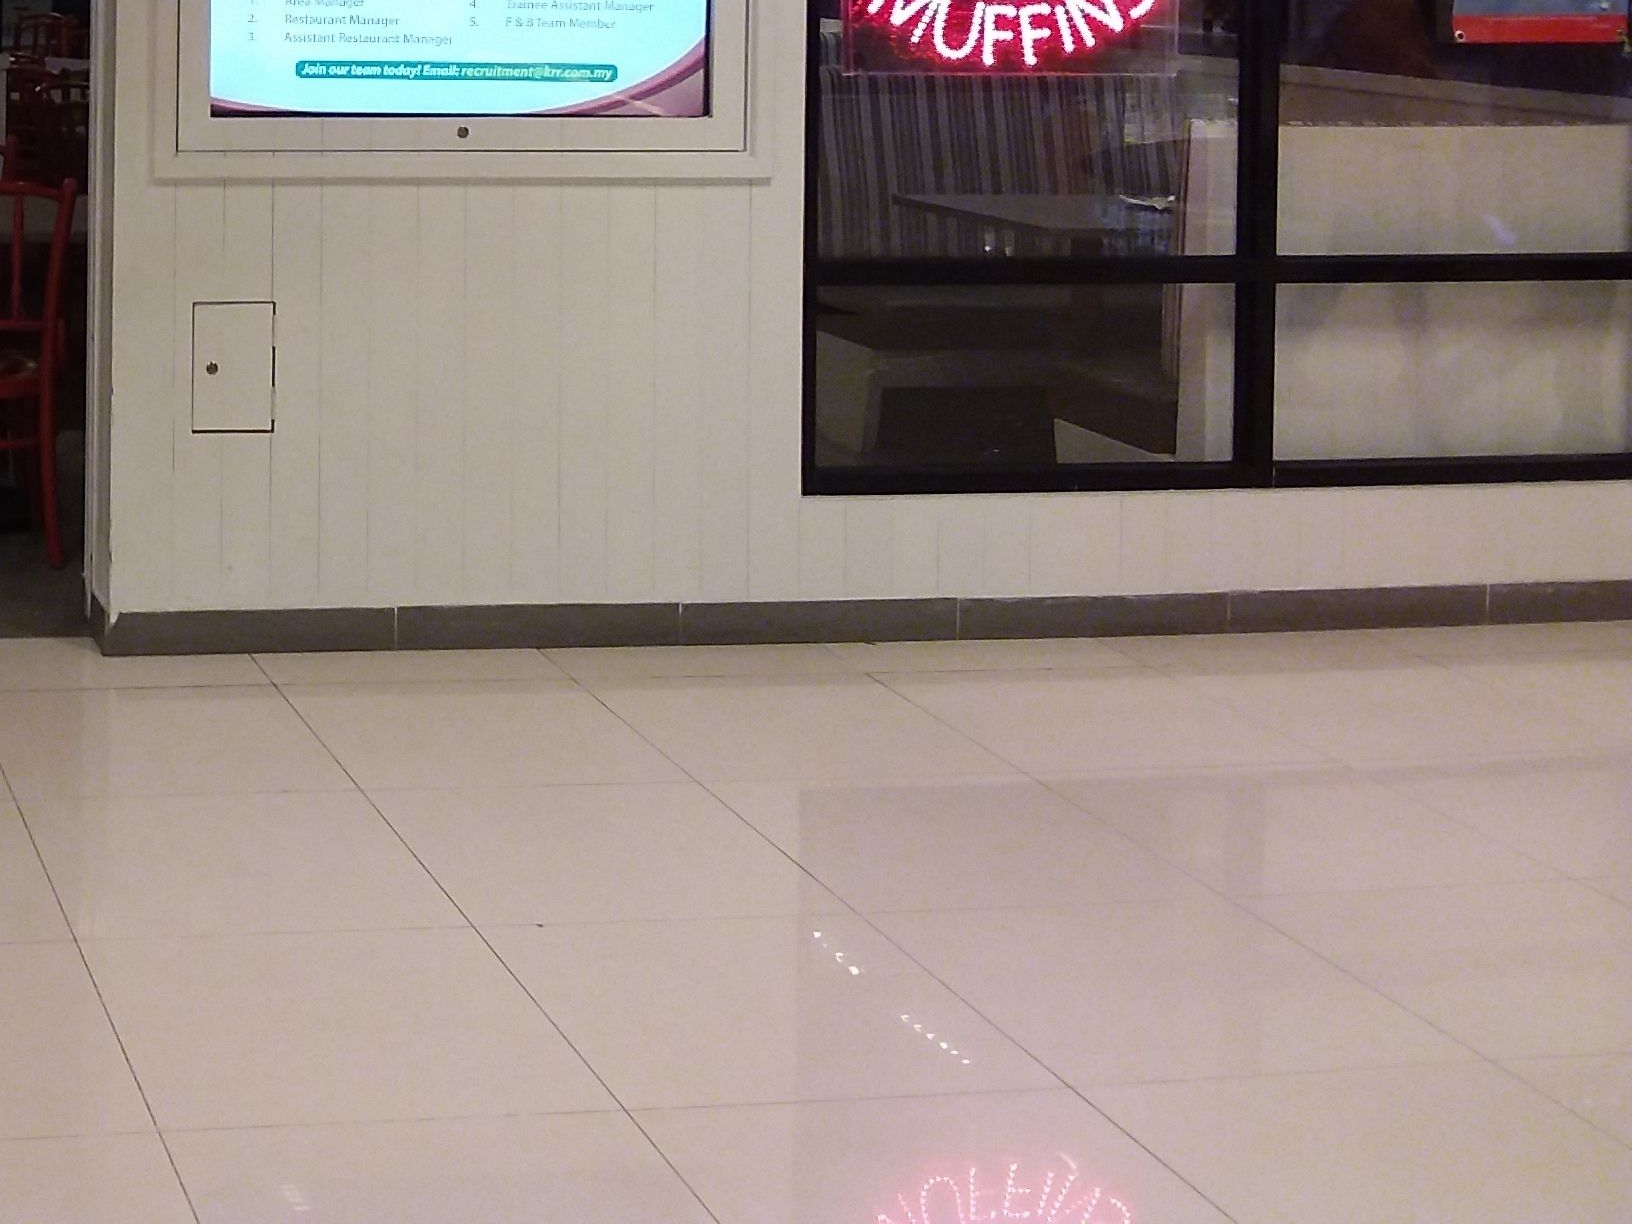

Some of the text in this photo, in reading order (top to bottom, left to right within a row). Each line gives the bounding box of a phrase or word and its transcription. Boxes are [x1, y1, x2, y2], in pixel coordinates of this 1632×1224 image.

[551, 0, 602, 11] Assistant
[604, 1, 655, 14] Manager
[285, 13, 347, 25] Restaurant
[349, 14, 400, 28] Manager
[536, 17, 566, 28] Team
[569, 17, 616, 30] Member
[284, 32, 336, 44] Assistant
[338, 33, 400, 45] Restaurant
[403, 33, 453, 47] Manager
[301, 62, 613, 81] Join our team today! Email: recruitment@krr.com.my
